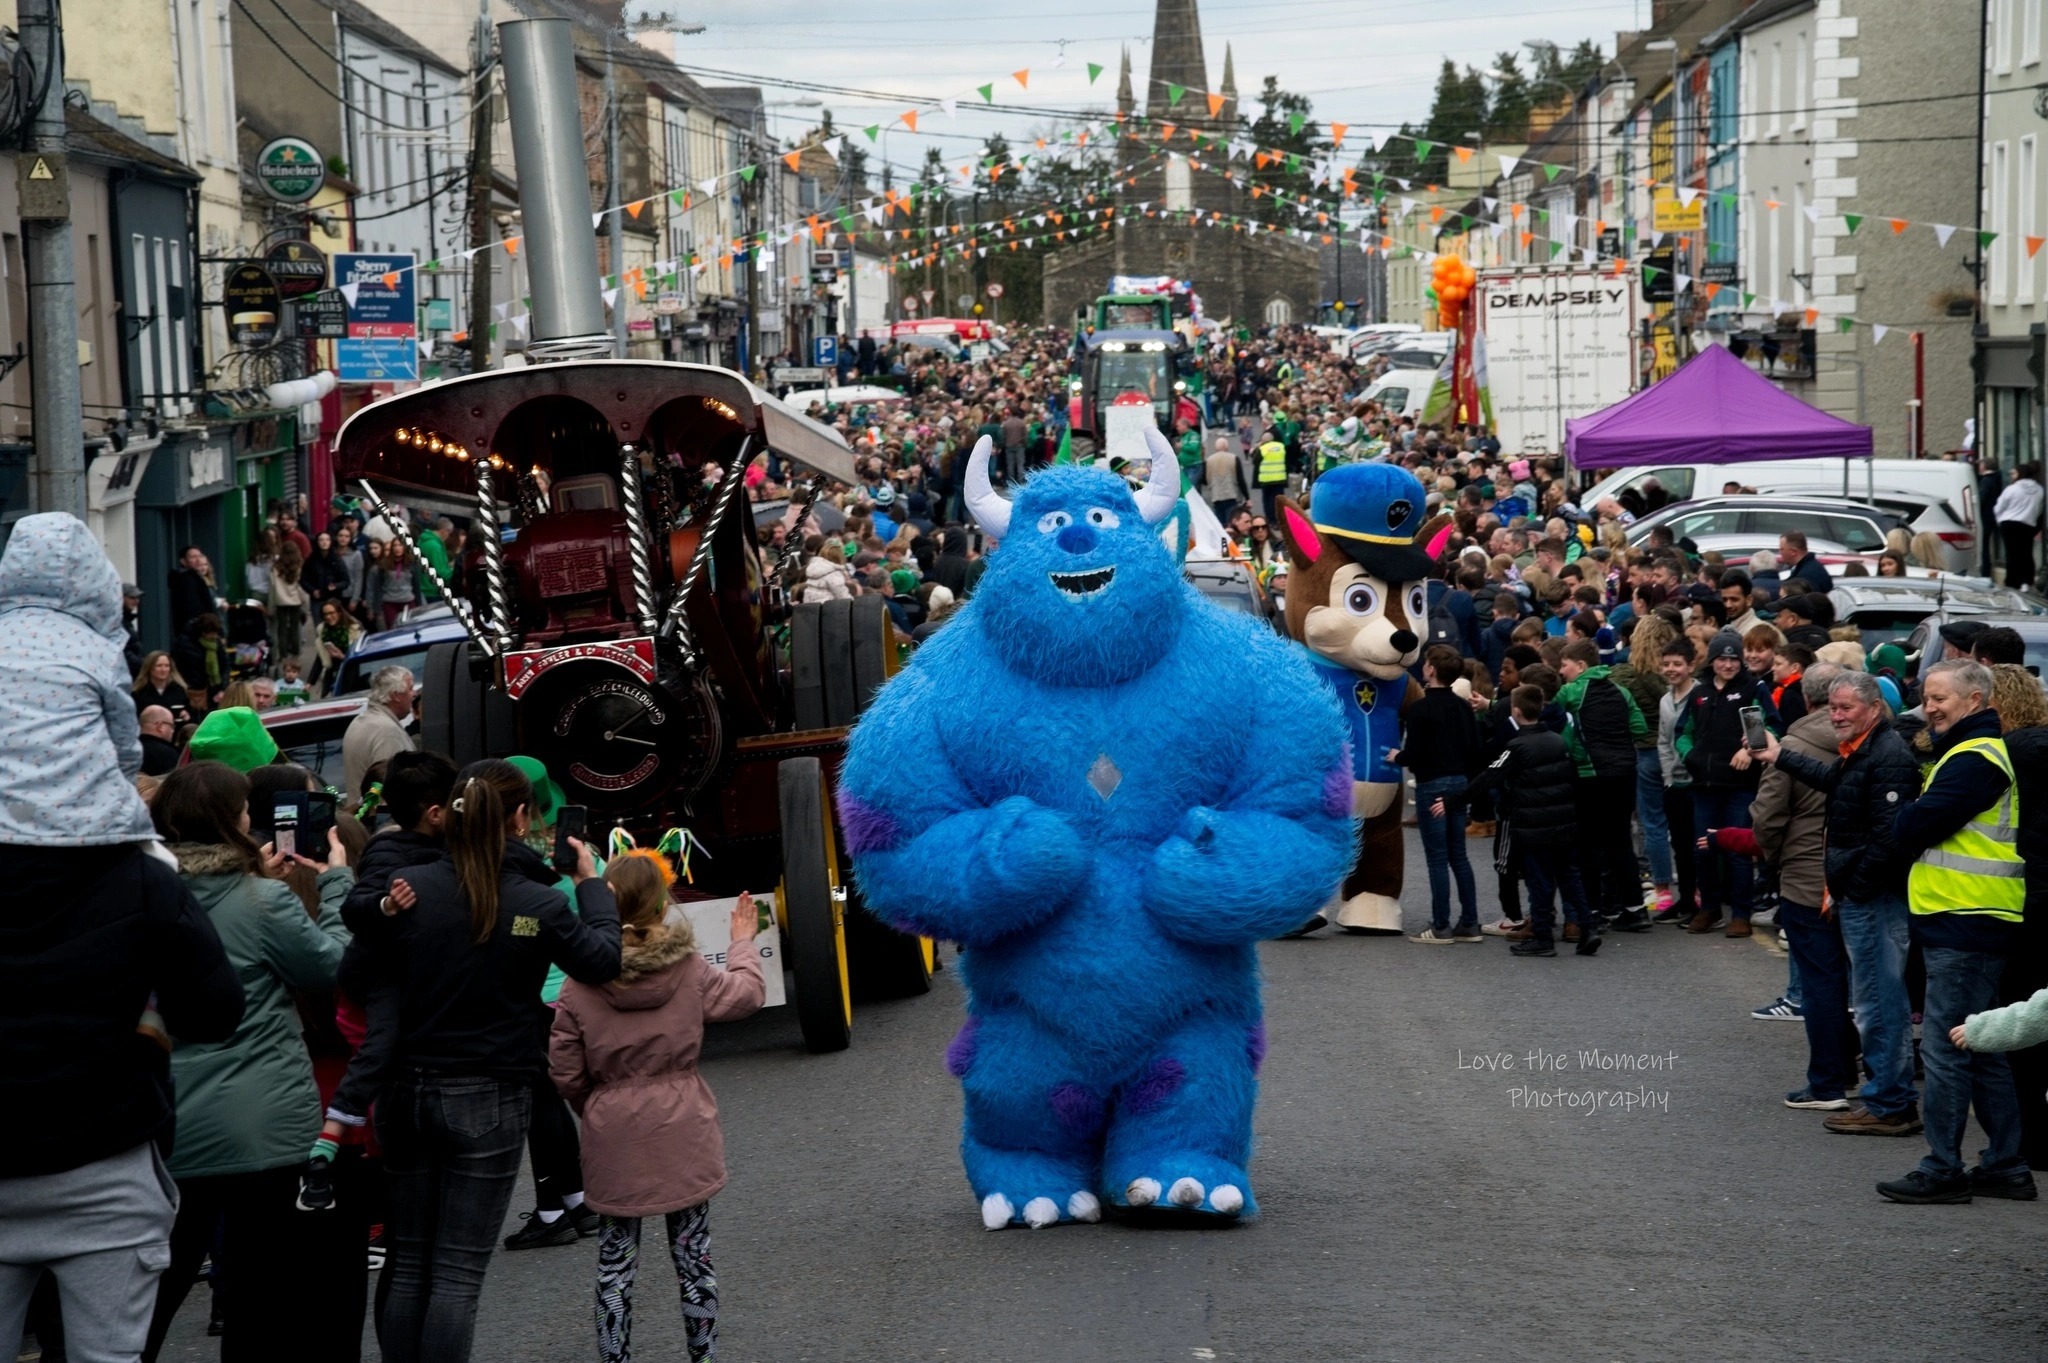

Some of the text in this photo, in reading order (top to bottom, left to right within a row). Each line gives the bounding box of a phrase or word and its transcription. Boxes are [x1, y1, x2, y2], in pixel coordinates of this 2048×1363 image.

[262, 165, 319, 176] Heineken
[265, 262, 324, 274] GUINNESS
[354, 260, 391, 273] Sherry
[1490, 289, 1624, 309] DEMPSEY
[299, 302, 343, 312] REPAIRS
[820, 338, 833, 355] P
[574, 648, 583, 657] &
